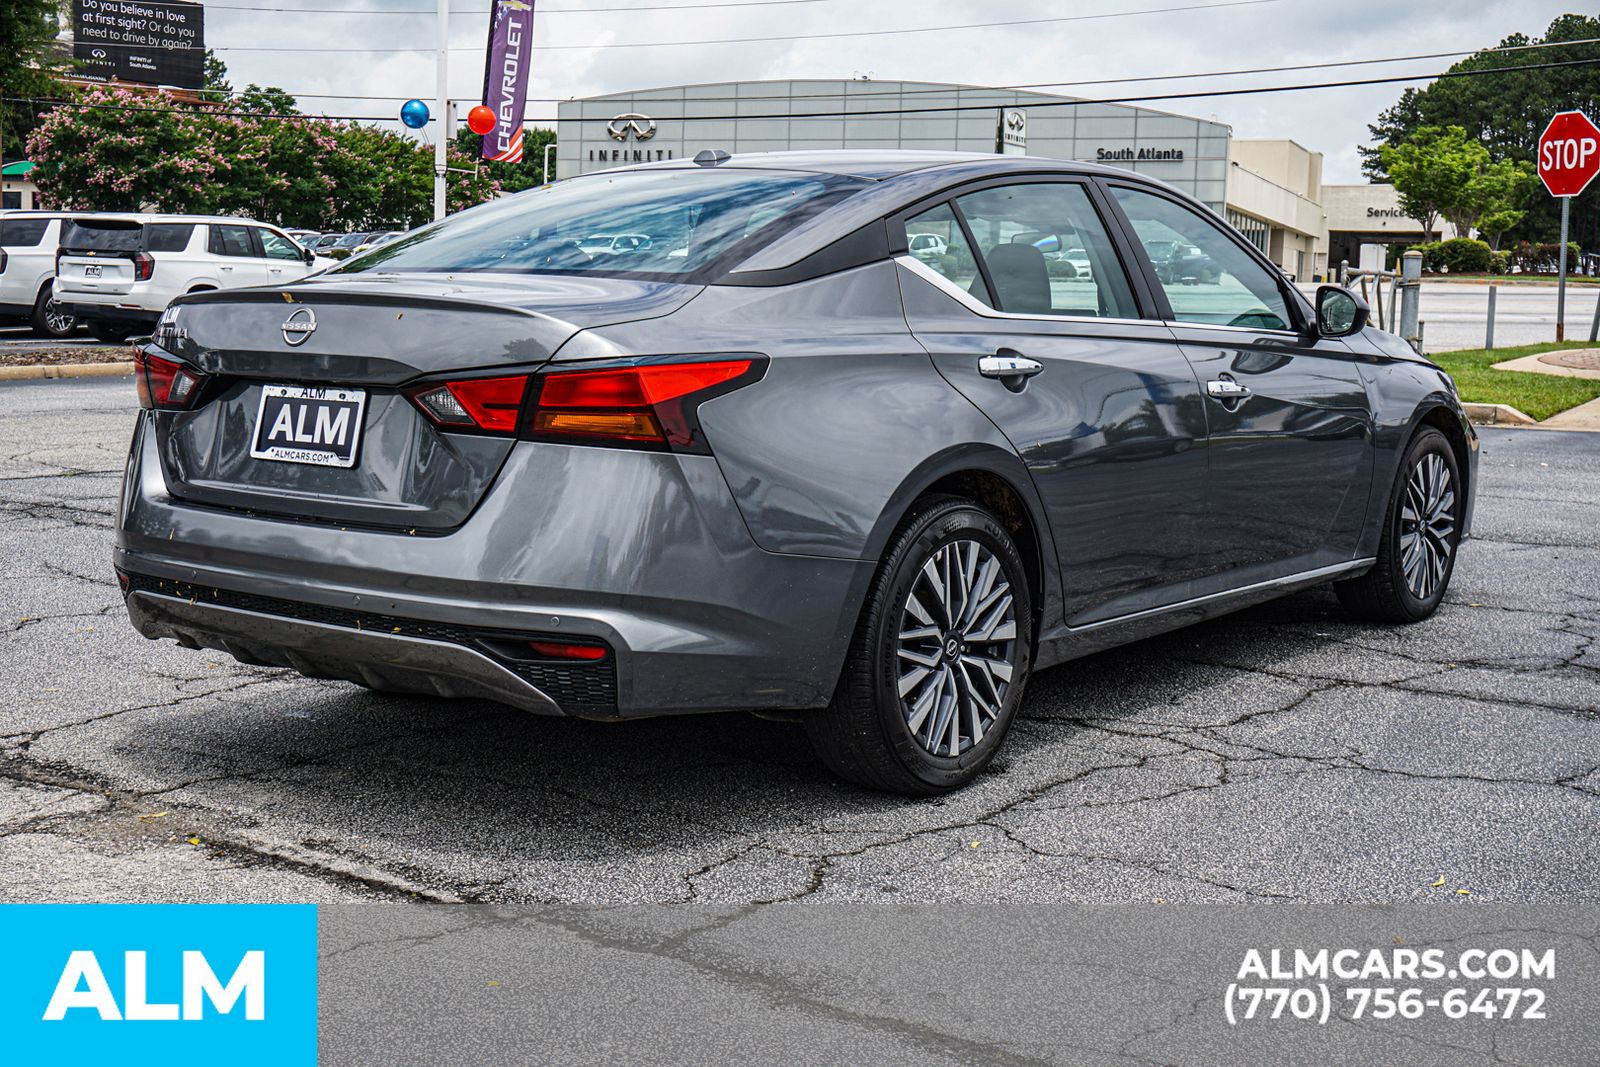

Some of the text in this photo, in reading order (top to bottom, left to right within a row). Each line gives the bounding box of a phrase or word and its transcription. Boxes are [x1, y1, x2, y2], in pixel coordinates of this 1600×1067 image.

[82, 0, 186, 23] Do you believe in love
[82, 13, 195, 38] at first sight? Or do you
[82, 27, 192, 50] need to drive by again?
[497, 17, 522, 152] CHEVROLET
[589, 149, 673, 162] INFINITI
[1096, 147, 1184, 160] South Atlanta
[1541, 137, 1597, 171] STOP
[281, 322, 317, 331] NISSAN
[300, 387, 326, 399] ALM
[267, 403, 351, 446] ALM
[274, 450, 330, 463] ALMCARS.COM
